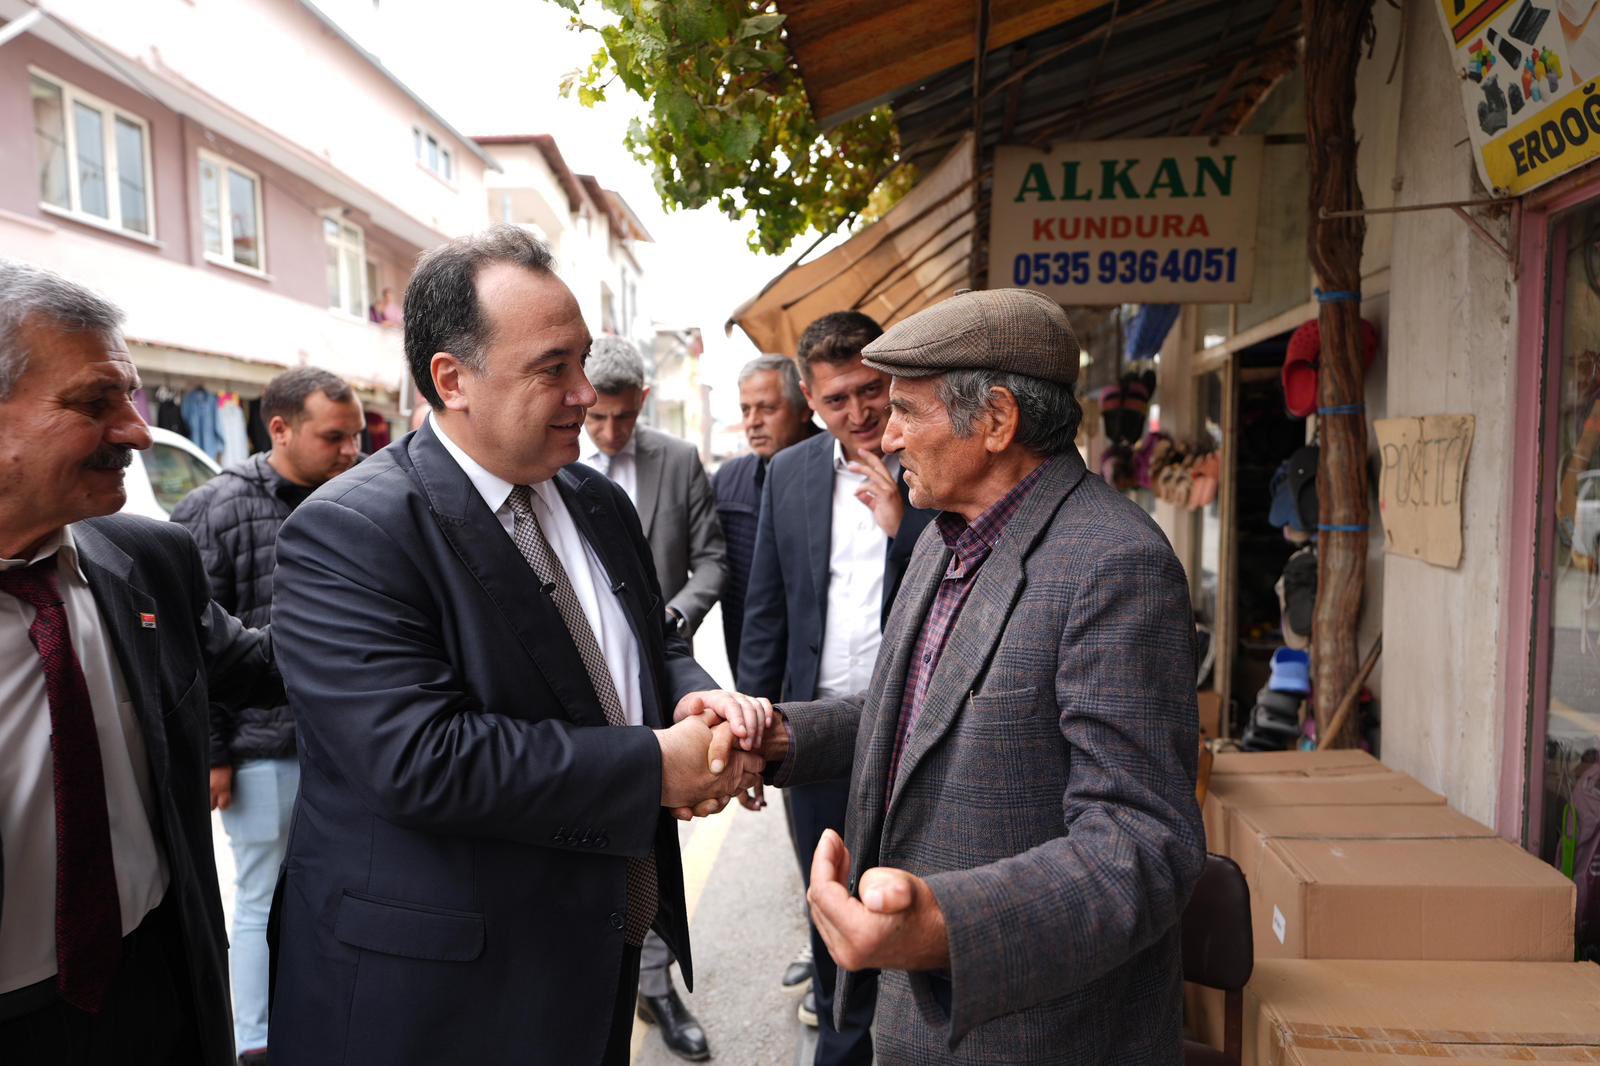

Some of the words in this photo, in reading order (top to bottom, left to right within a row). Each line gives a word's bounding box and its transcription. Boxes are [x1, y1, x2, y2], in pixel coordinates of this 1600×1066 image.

[1013, 155, 1237, 202] ALKAN
[1032, 213, 1211, 242] KUNDURA
[1013, 252, 1091, 287] 0535
